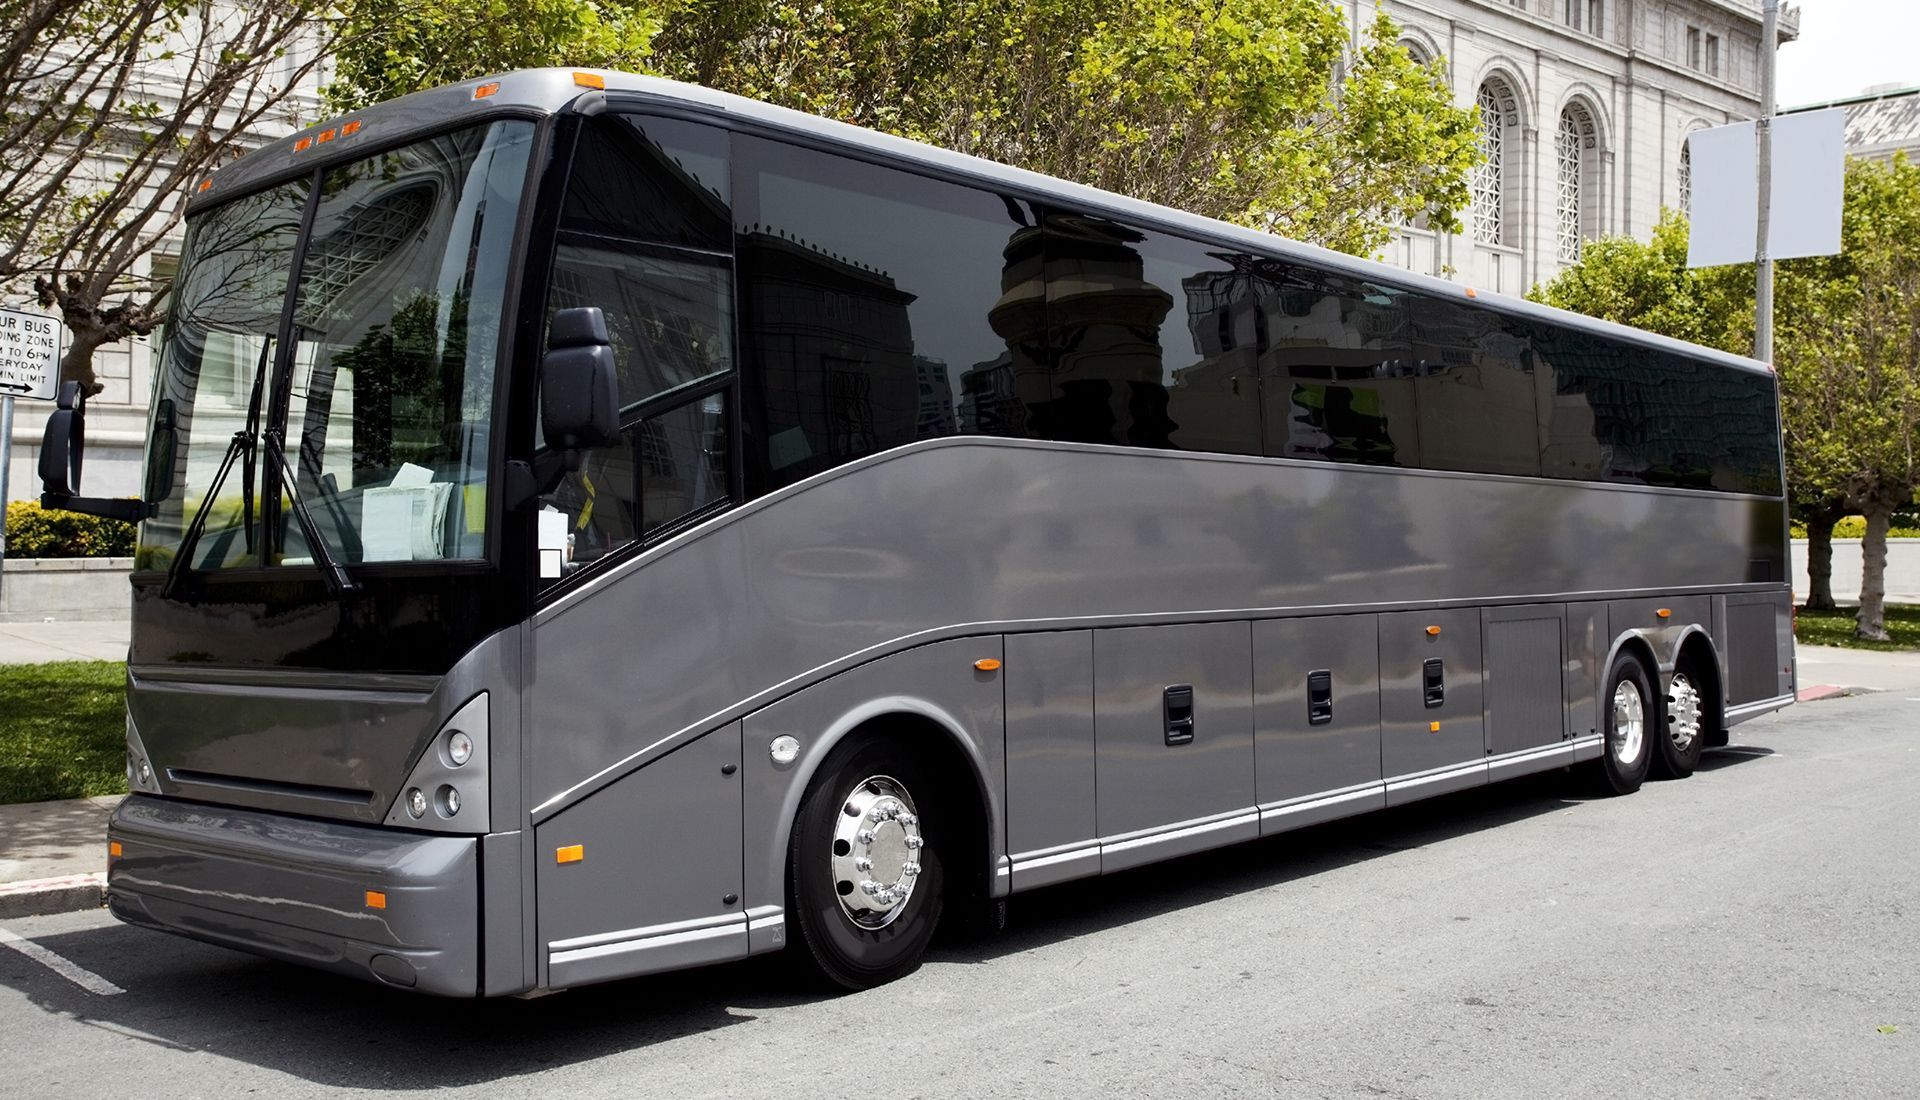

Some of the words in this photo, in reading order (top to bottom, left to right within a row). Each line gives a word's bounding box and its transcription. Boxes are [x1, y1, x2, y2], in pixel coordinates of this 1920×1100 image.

[25, 321, 50, 334] BUS
[27, 335, 54, 348] ZONE
[9, 347, 21, 357] TO
[27, 349, 50, 361] 6PM
[0, 359, 43, 370] ERYDAY
[21, 374, 46, 383] LIMIT
